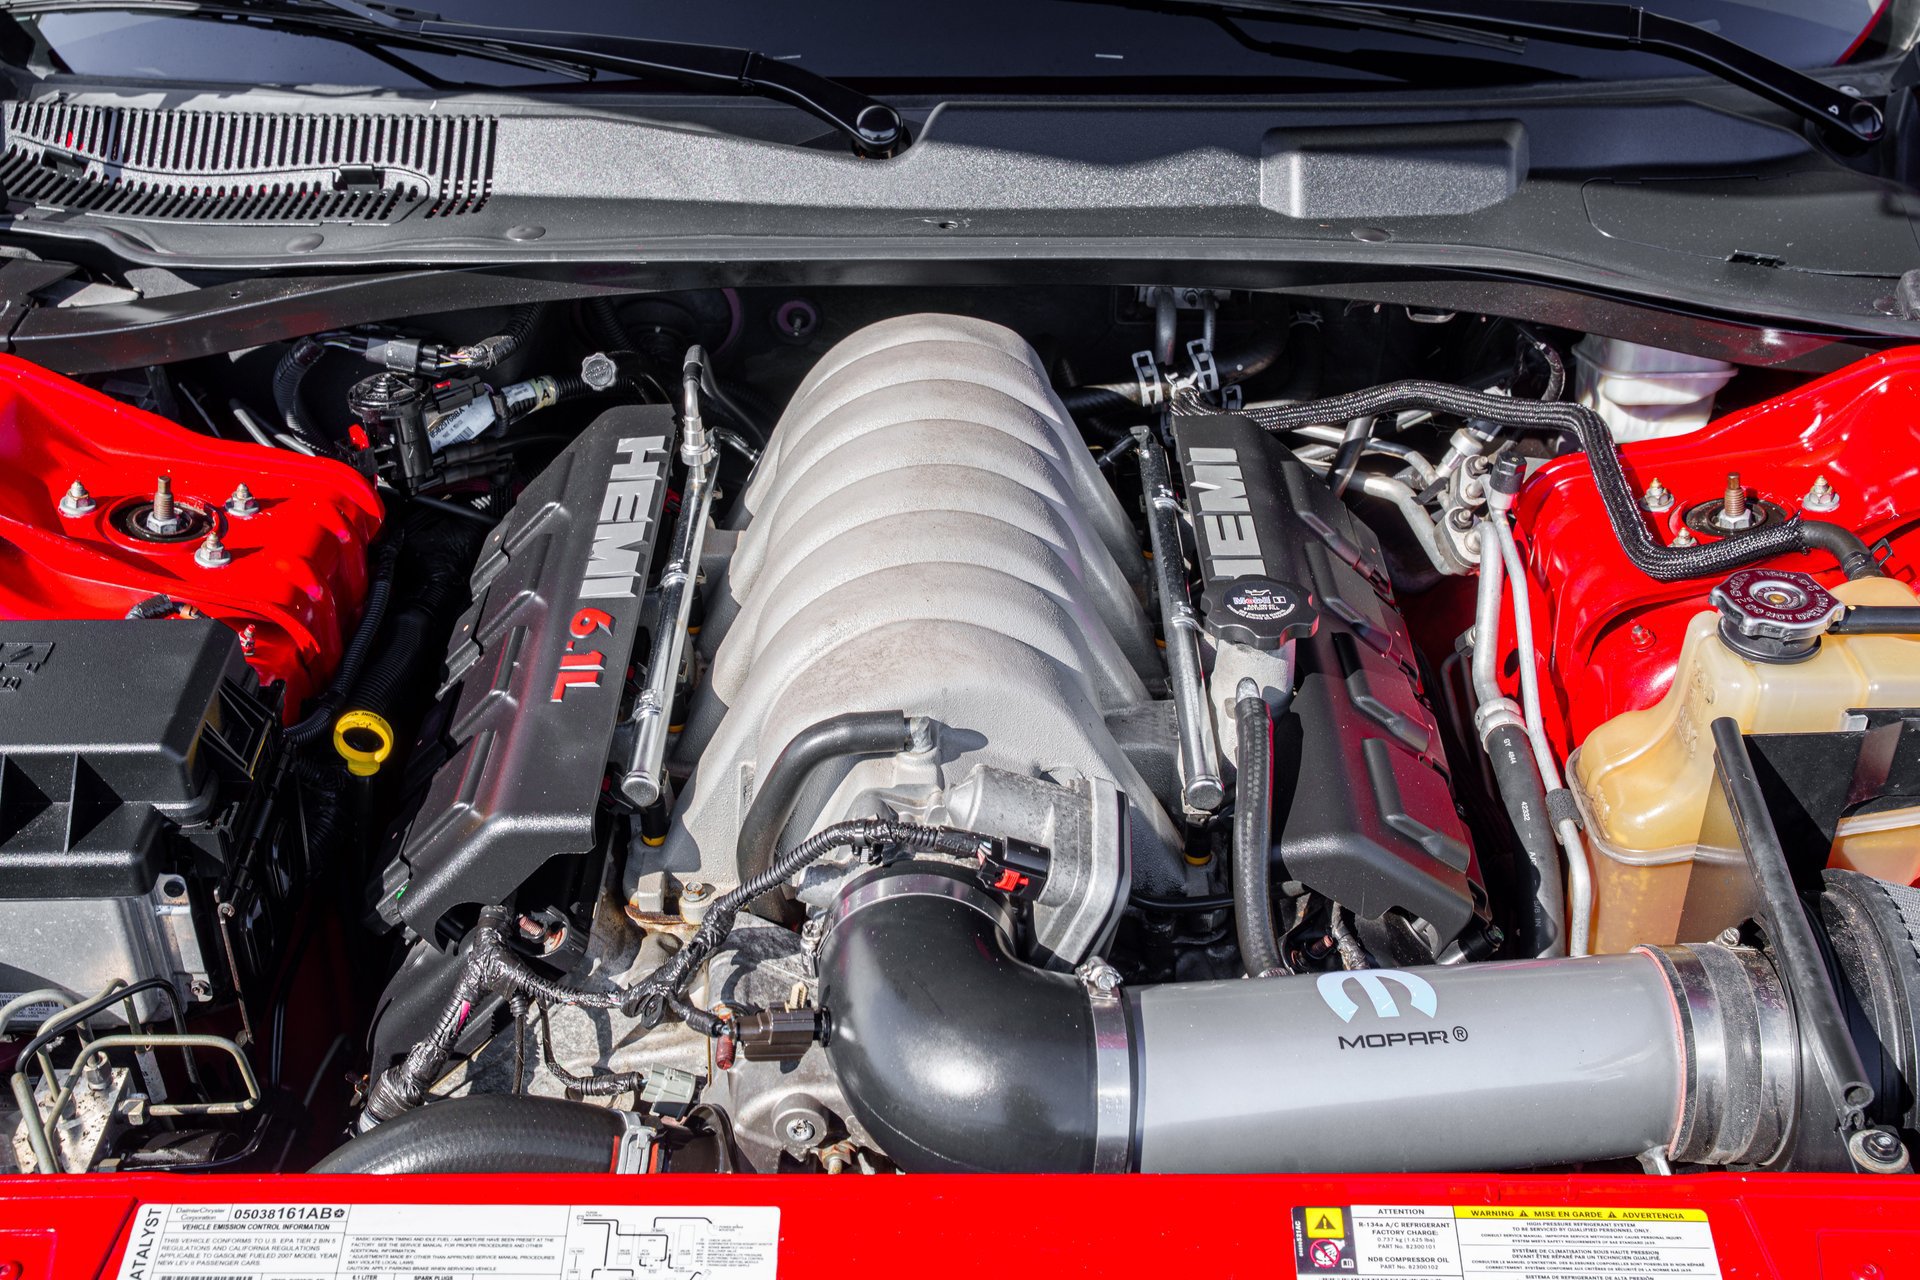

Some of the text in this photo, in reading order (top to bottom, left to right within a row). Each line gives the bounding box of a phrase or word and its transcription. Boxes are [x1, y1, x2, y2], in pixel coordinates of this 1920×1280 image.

[550, 435, 668, 702] HEMI 6.1L
[232, 1208, 334, 1219] 05038161AB
